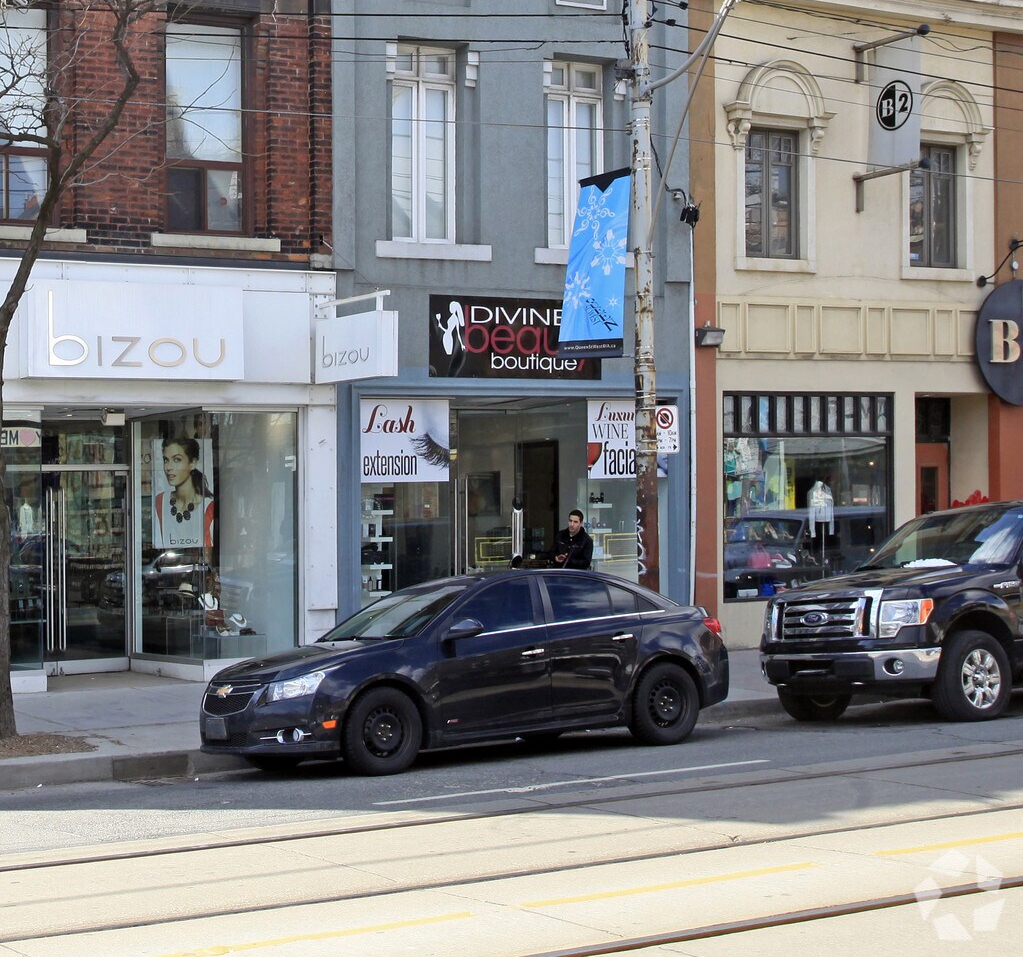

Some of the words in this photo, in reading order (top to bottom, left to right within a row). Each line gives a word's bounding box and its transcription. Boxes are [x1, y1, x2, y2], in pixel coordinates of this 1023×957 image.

[471, 306, 562, 326] DIVINE
[491, 352, 577, 374] boutique
[362, 404, 416, 434] Lash
[592, 424, 629, 440] WINE
[363, 449, 417, 476] extension
[603, 441, 636, 476] facia
